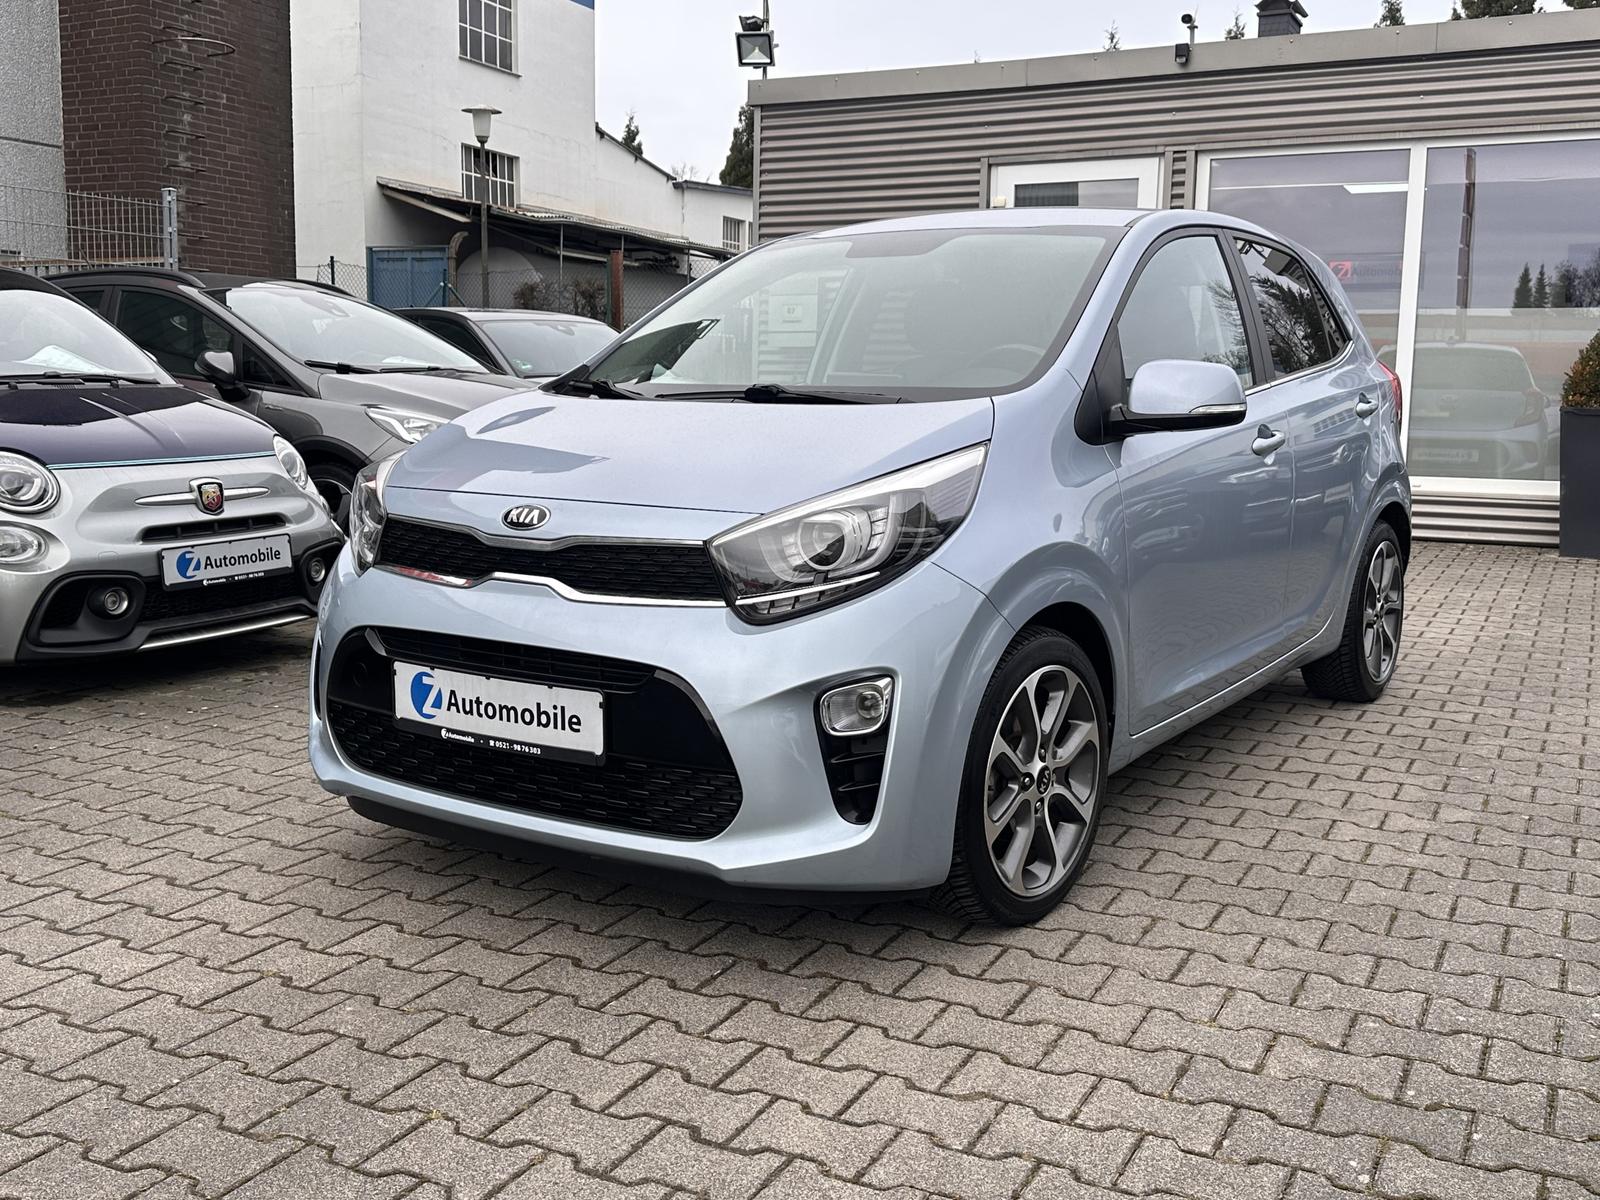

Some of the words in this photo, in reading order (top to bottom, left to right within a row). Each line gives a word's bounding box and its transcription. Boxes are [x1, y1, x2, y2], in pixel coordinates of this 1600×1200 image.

[507, 508, 540, 524] KIA
[204, 547, 281, 570] Automobile
[446, 690, 582, 733] Automobile
[448, 732, 475, 744] Automobile
